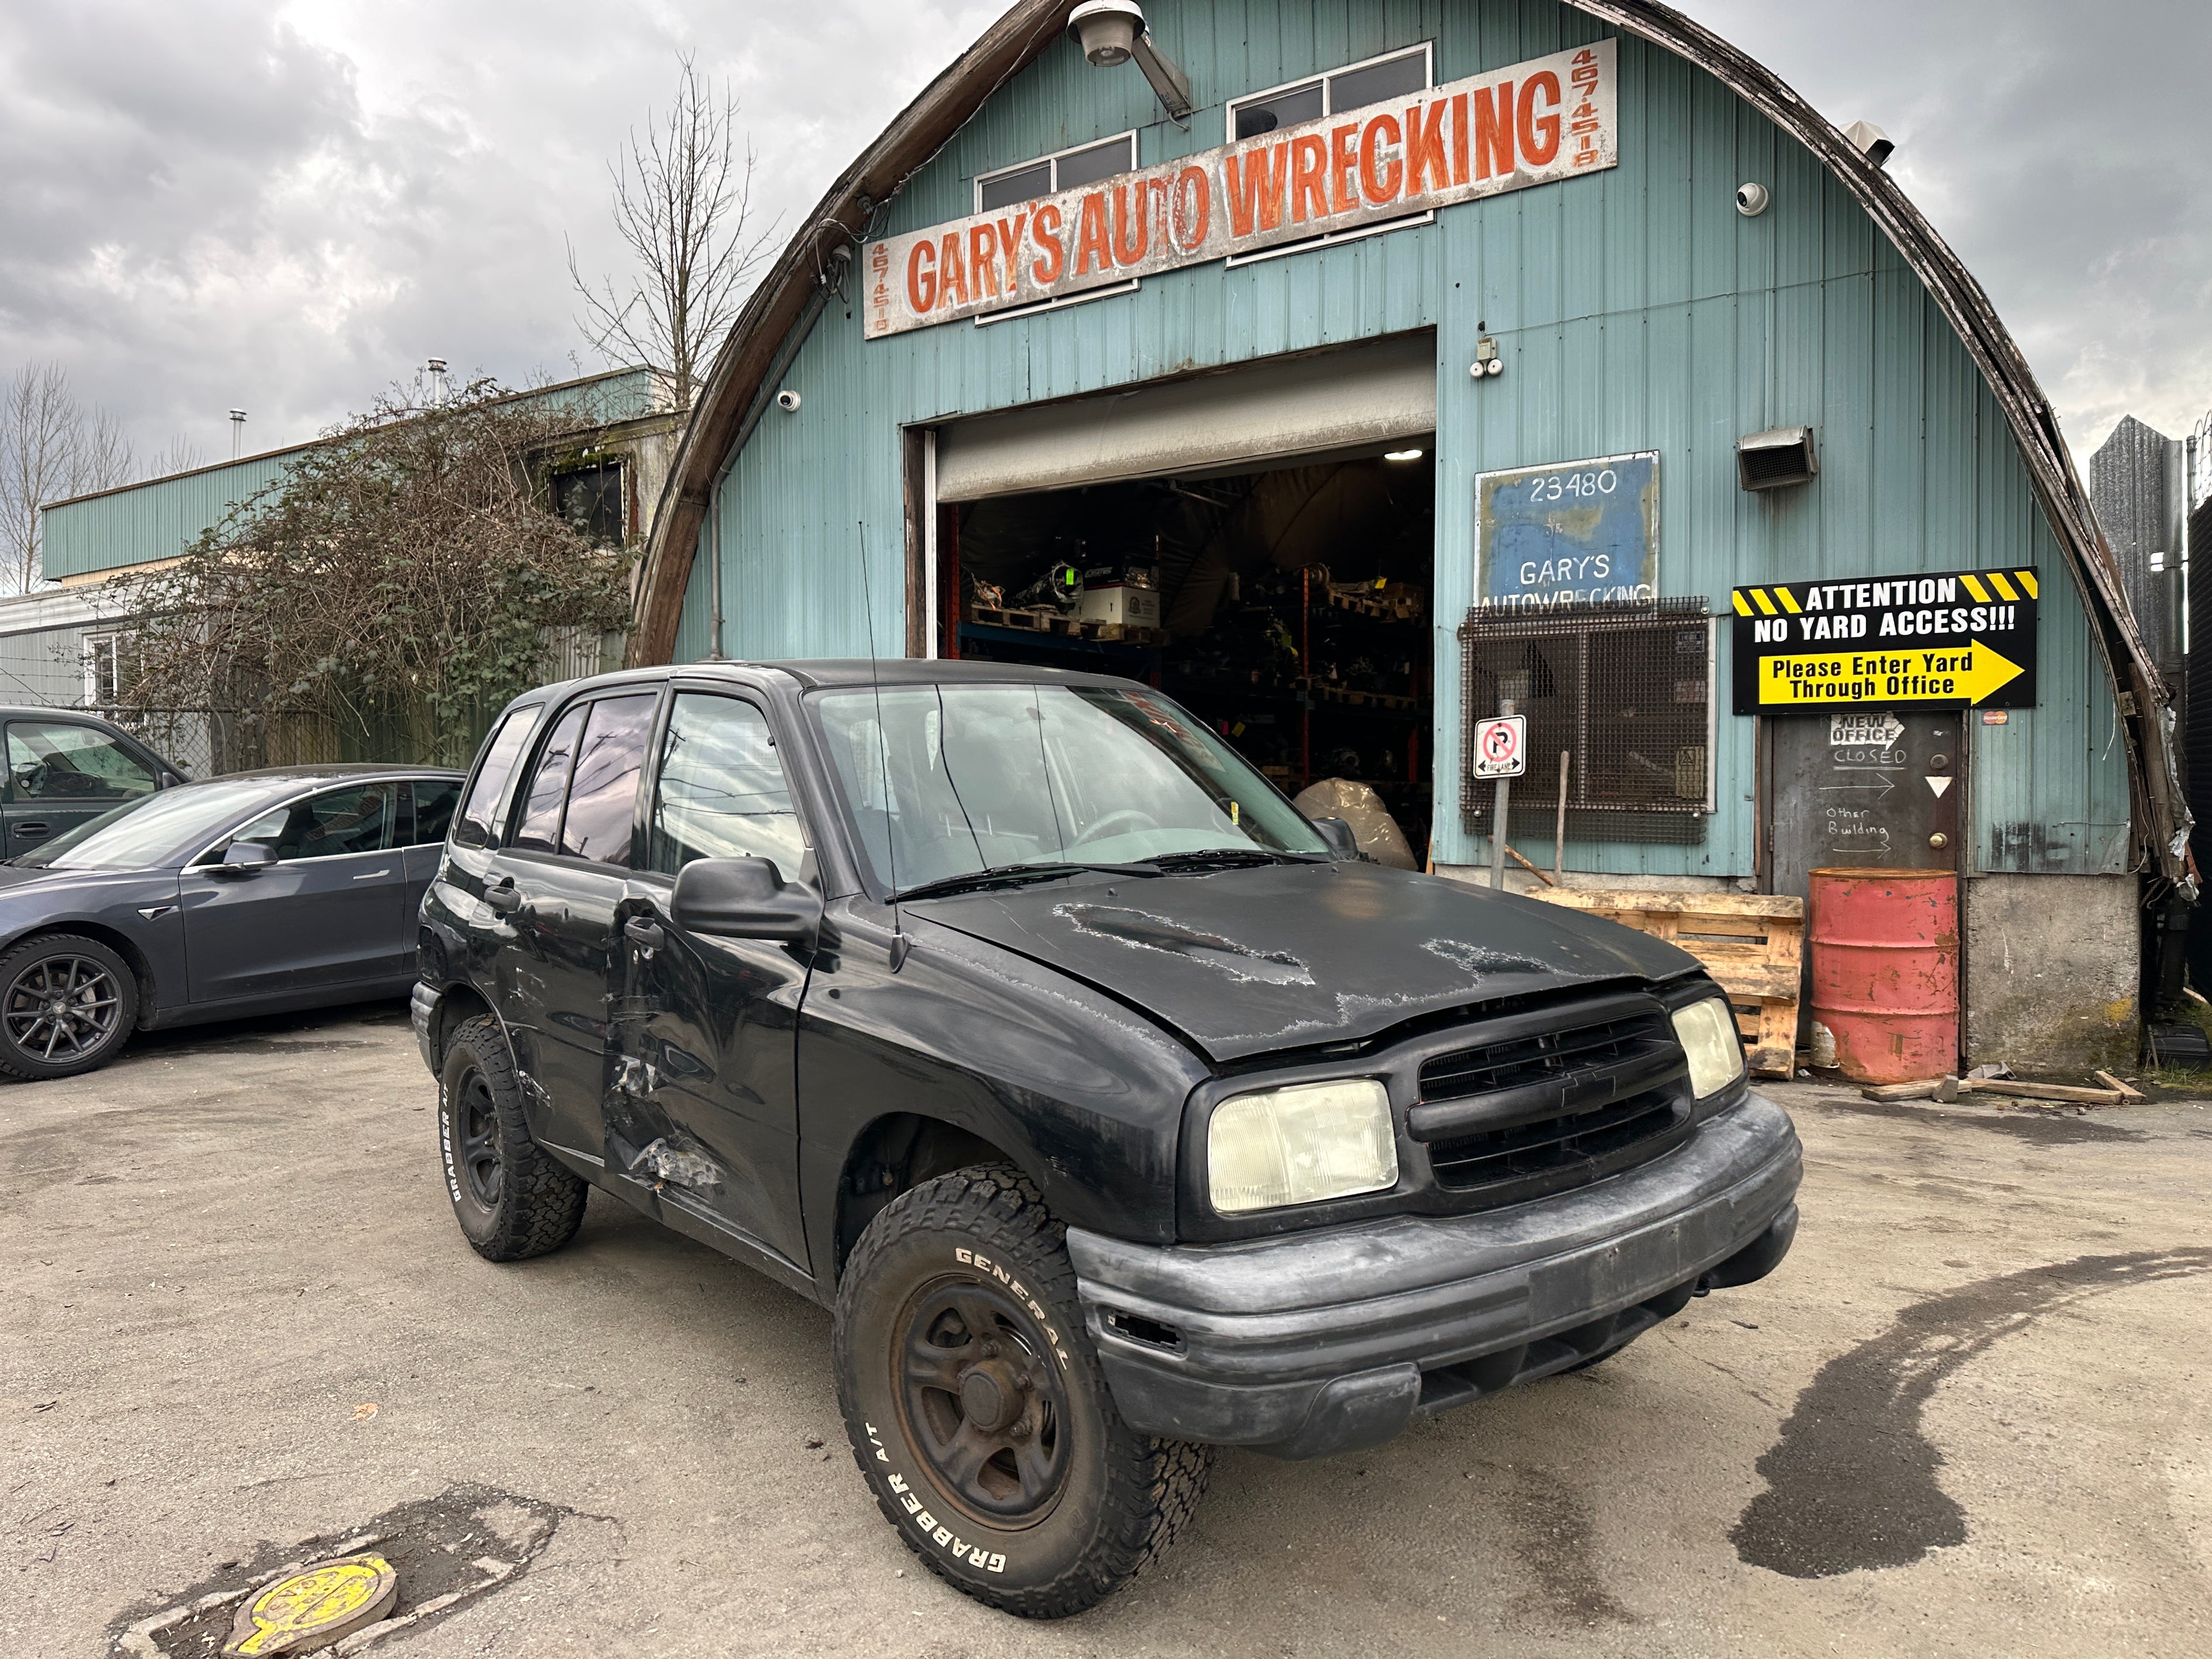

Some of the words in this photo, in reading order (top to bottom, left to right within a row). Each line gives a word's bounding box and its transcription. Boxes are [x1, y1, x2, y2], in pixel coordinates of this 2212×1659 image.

[904, 201, 1063, 315] GARY'S
[1072, 165, 1210, 276] AUTO
[1225, 70, 1562, 238] WRECKING
[1529, 469, 1617, 502] 23480
[1520, 554, 1609, 585] GARY'S
[1805, 577, 1956, 611] ATTENTION
[1754, 618, 1788, 643] NO
[1799, 613, 1867, 641] YARD
[1878, 605, 2015, 637] ACCESS!!!
[1773, 660, 1842, 679] Please
[1853, 656, 1911, 675] Enter
[1922, 652, 1972, 673] Yard
[1790, 677, 1876, 699] Through
[1887, 676, 1955, 695] Office
[1833, 728, 1895, 742] OFFICE
[1842, 715, 1885, 728] NEW
[1834, 749, 1907, 764] CLOSED
[442, 1111, 461, 1202] GRABBER
[955, 1247, 1070, 1370] GENERAL
[865, 1421, 890, 1463] A/T
[887, 1472, 1007, 1574] GRABBER
